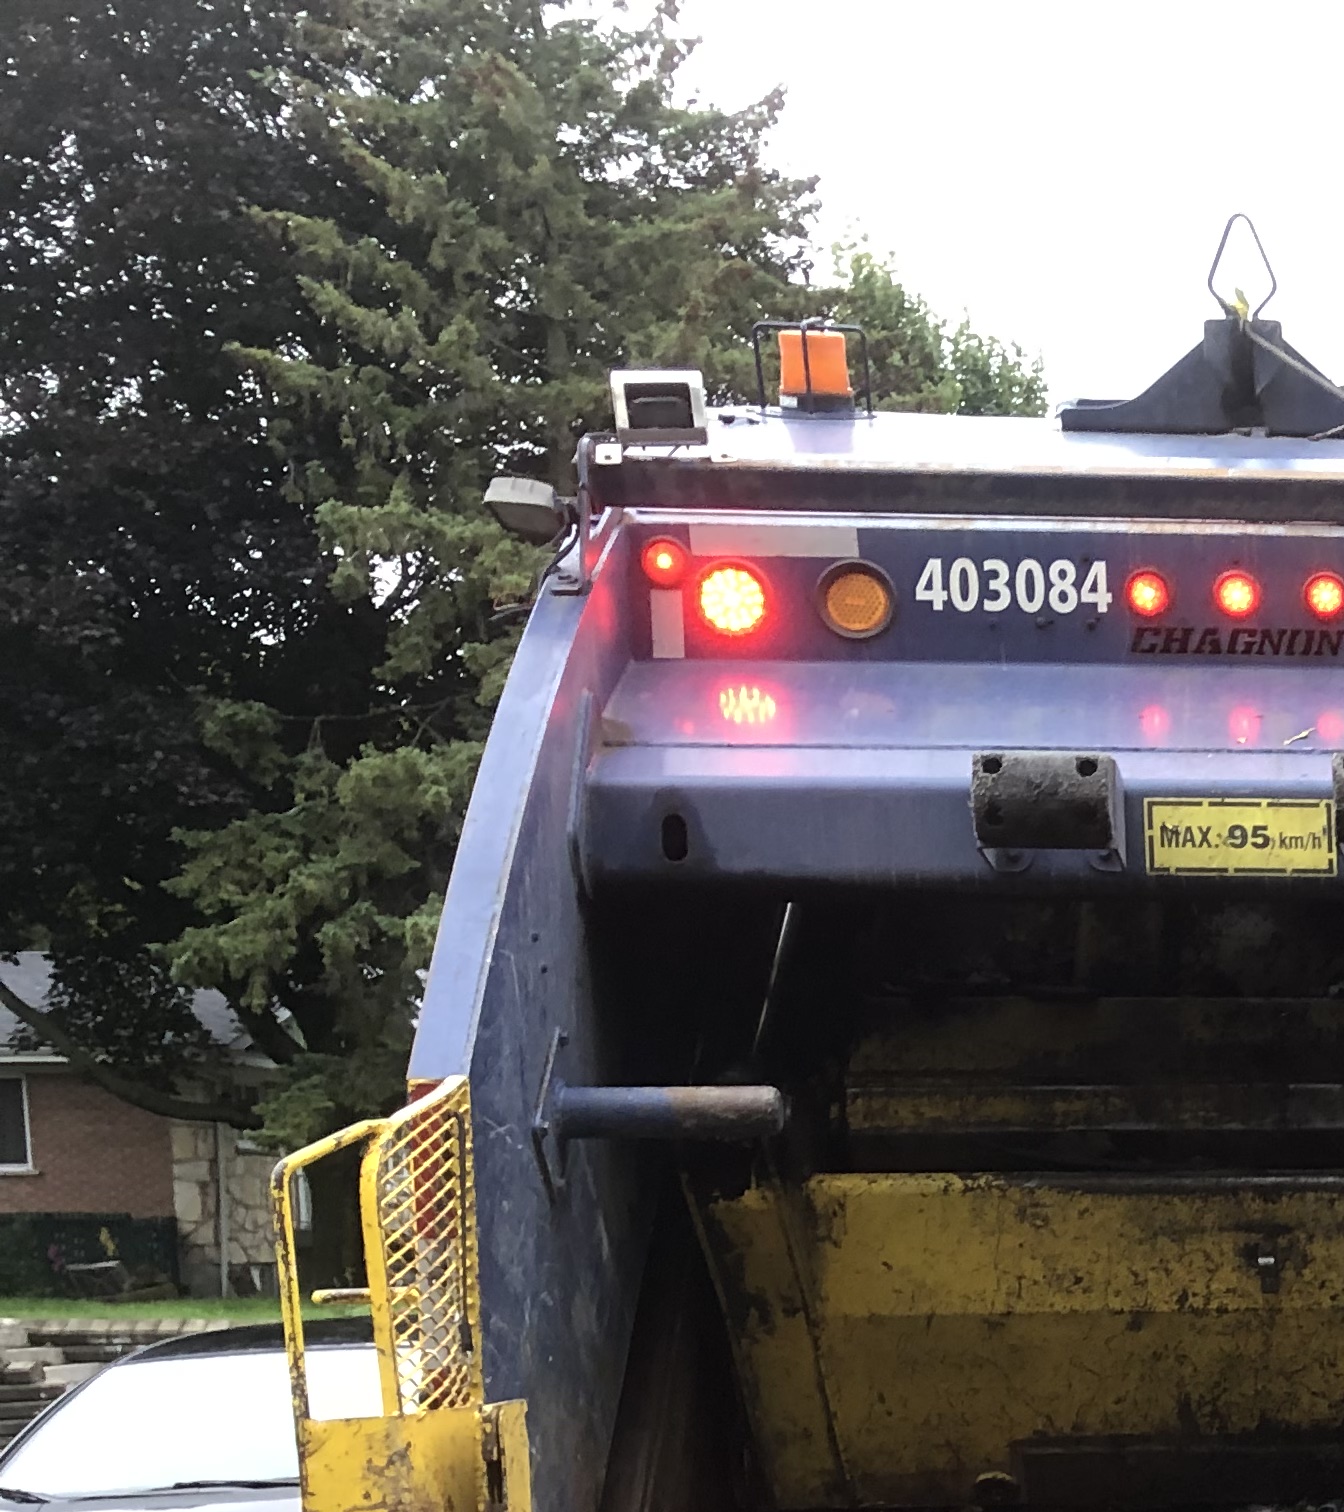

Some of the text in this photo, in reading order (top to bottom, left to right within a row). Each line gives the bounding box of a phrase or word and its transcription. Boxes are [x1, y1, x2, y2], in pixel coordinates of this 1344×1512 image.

[914, 556, 1113, 615] 403084
[1227, 824, 1270, 850] 95
[1278, 831, 1322, 851] km/h
